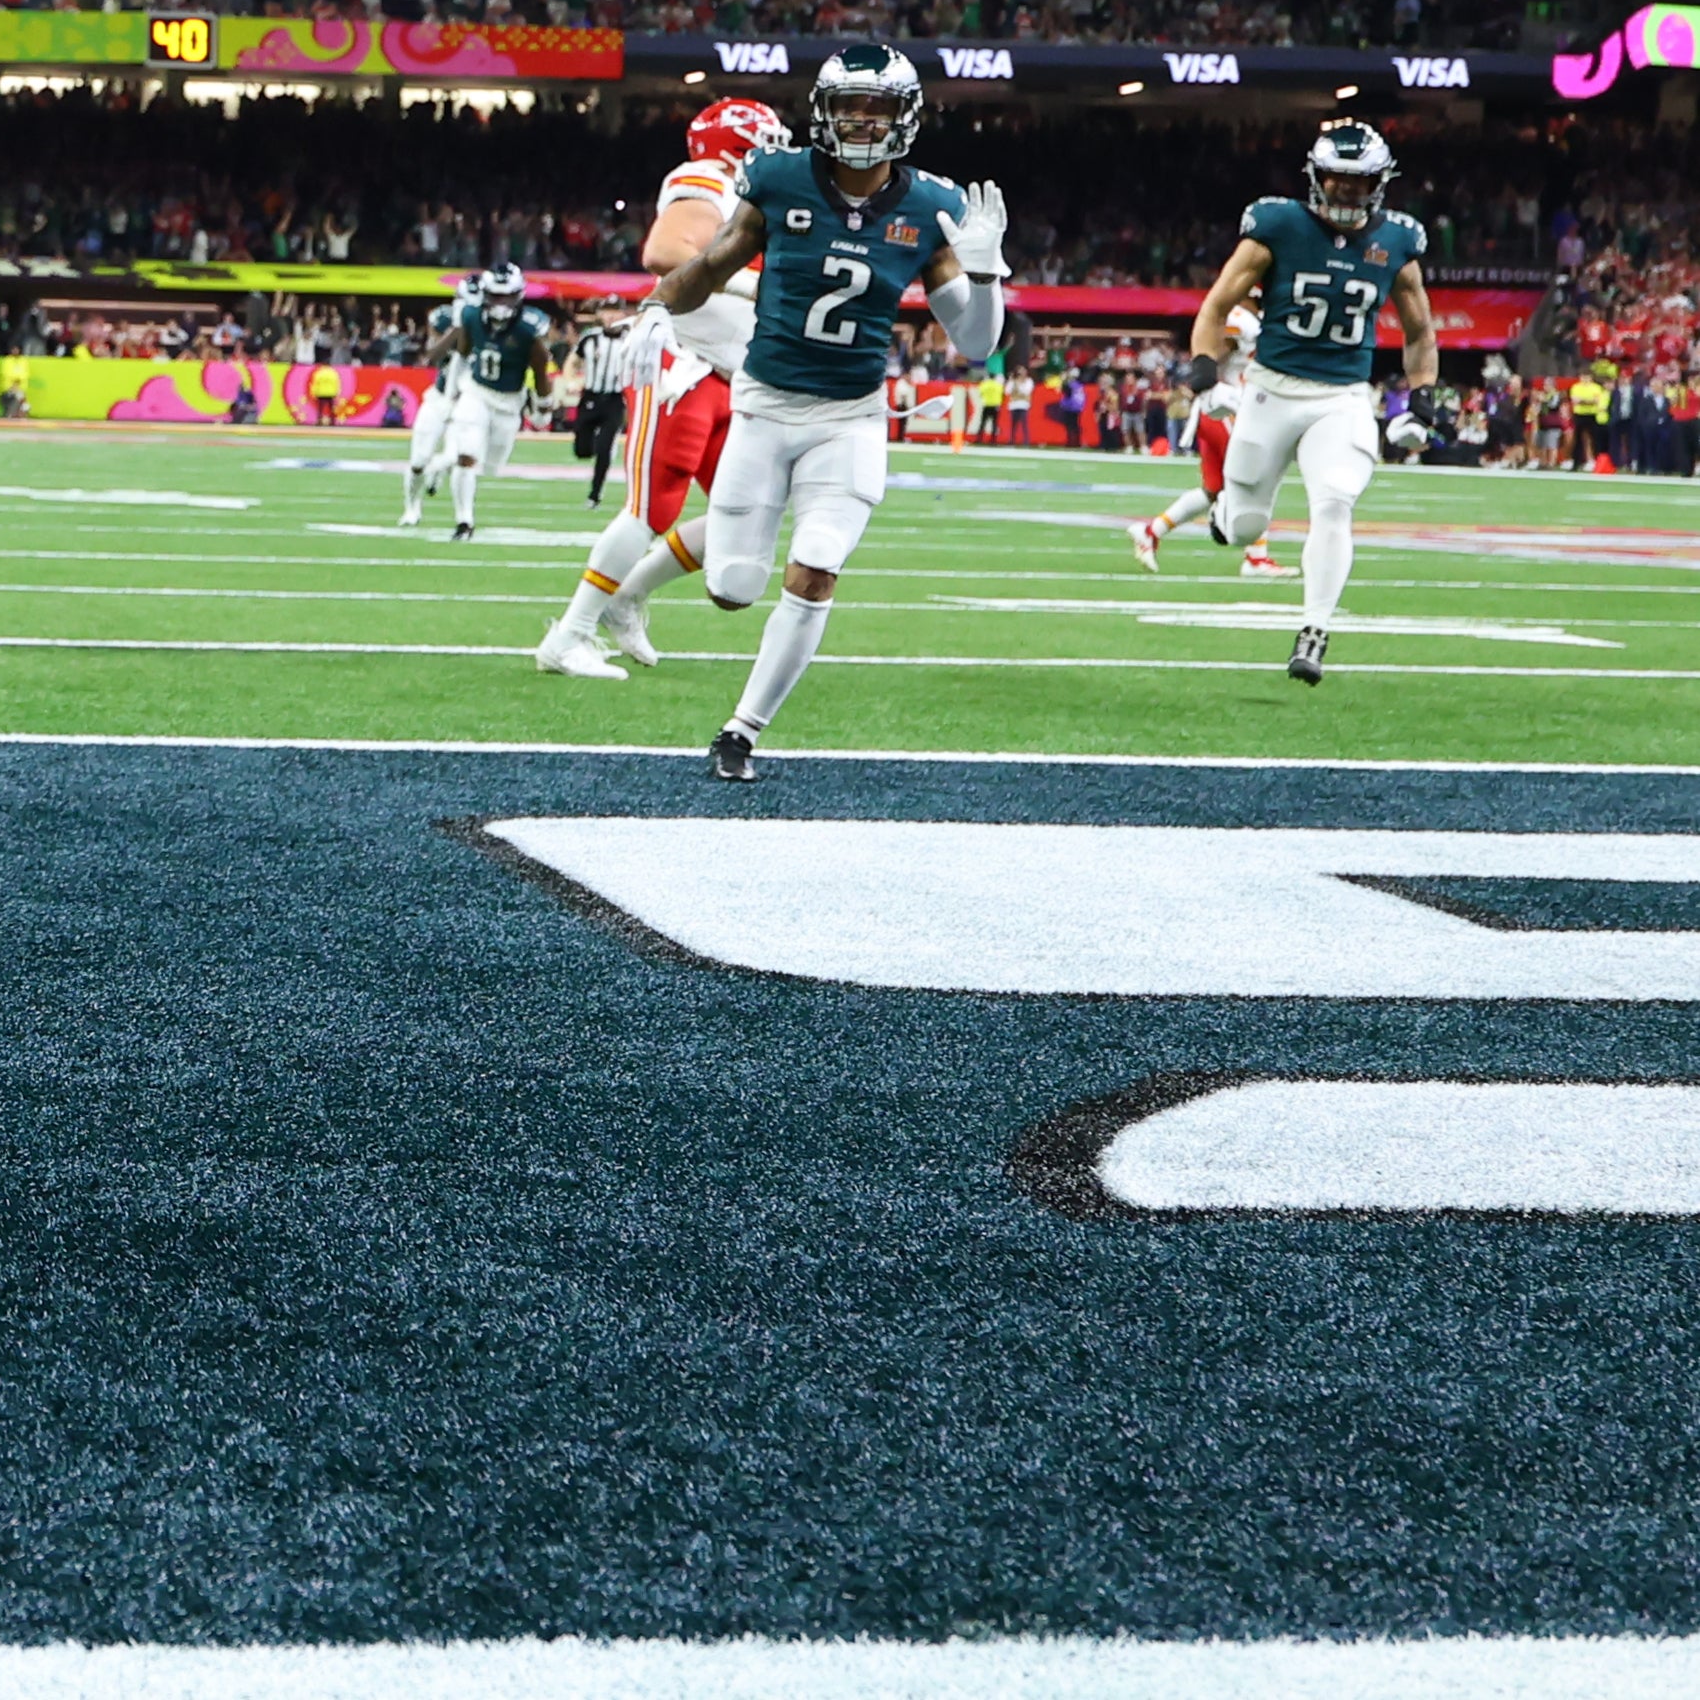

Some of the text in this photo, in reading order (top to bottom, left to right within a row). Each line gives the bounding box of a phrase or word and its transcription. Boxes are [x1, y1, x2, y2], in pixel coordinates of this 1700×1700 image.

[151, 18, 209, 62] 40
[713, 42, 789, 74] VISA
[936, 47, 1014, 79] VISA
[1163, 53, 1240, 84] VISA
[1391, 57, 1470, 88] VISA
[786, 208, 813, 230] C
[804, 254, 872, 347] 2
[1286, 271, 1379, 346] 53
